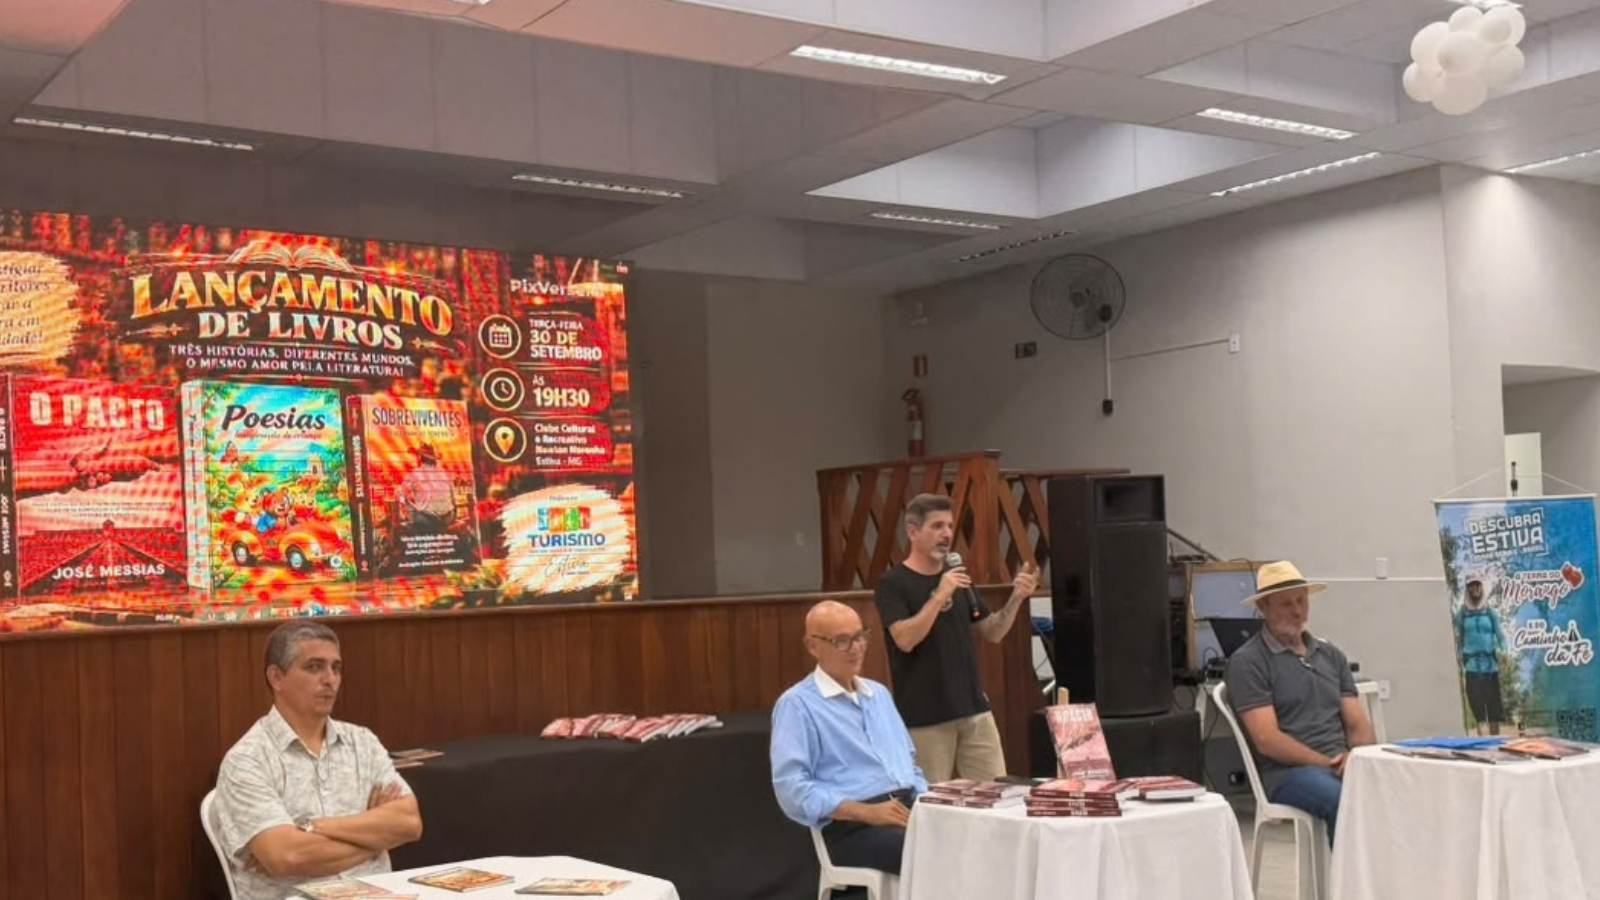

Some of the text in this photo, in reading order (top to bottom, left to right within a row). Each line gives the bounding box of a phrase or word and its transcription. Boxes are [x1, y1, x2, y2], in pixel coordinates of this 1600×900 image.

[131, 270, 453, 335] LANÇAMENTO
[199, 311, 404, 350] DE LIVROS
[530, 329, 578, 345] 30 DE
[169, 342, 203, 356] TRÊS
[284, 347, 358, 361] DIFERENTES
[530, 344, 603, 361] SETEMBRO
[187, 357, 196, 369] O
[200, 357, 248, 370] MESMO
[251, 359, 289, 372] AMOR
[292, 360, 324, 373] PELA
[533, 387, 590, 407] 19H30
[30, 392, 165, 431] O PACTO
[221, 404, 326, 431] Poesias
[372, 407, 463, 428] SOBREVIVENTES
[1469, 512, 1543, 534] DESCUBRA
[527, 533, 606, 548] TURISMO
[1472, 526, 1544, 554] ESTIVA
[52, 562, 165, 580] JOSÉ MESSIAS
[1502, 579, 1569, 605] Morango
[1514, 628, 1568, 648] Caminho
[1547, 642, 1569, 662] da
